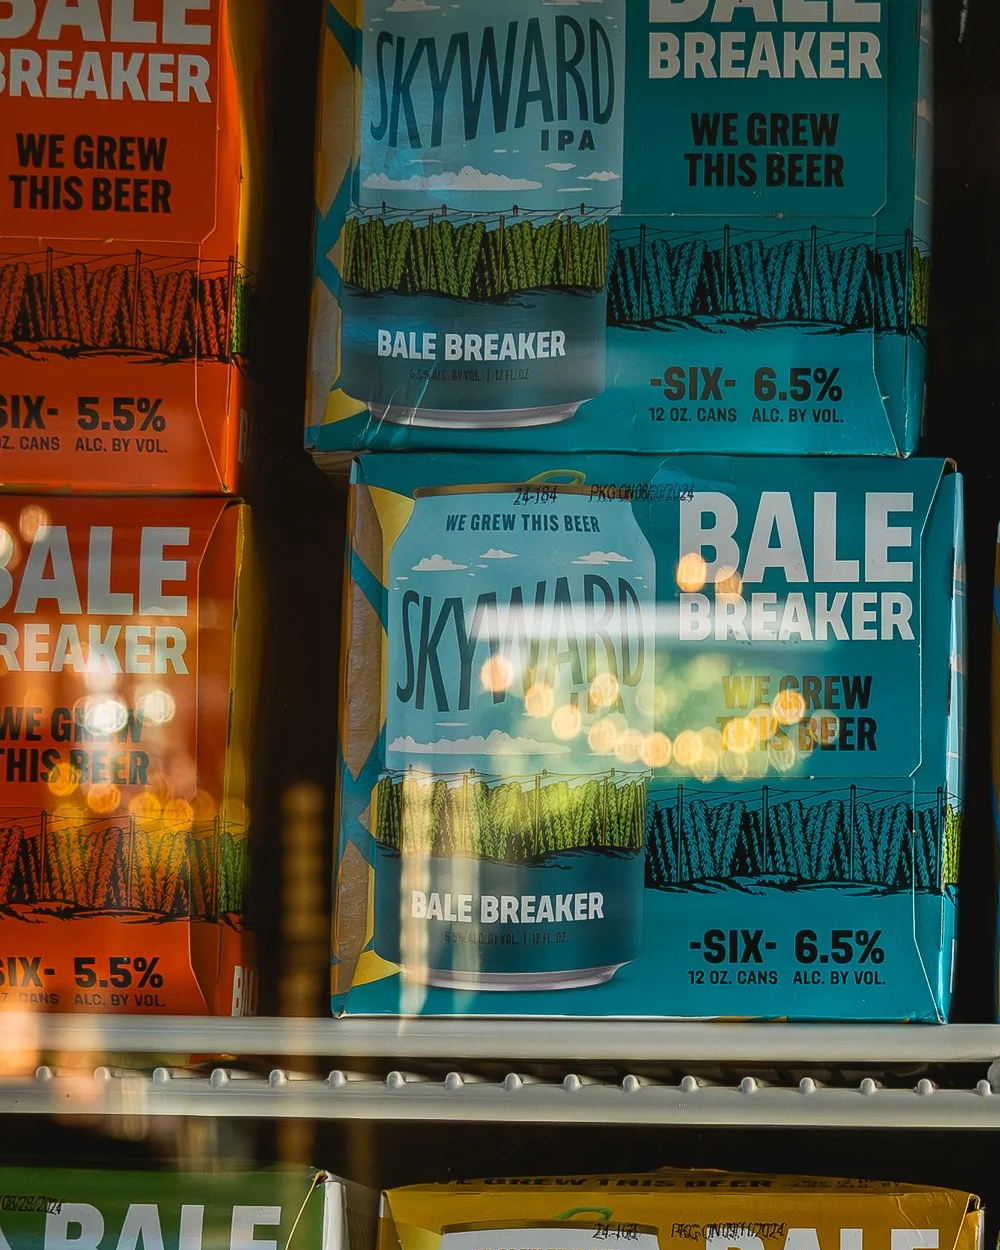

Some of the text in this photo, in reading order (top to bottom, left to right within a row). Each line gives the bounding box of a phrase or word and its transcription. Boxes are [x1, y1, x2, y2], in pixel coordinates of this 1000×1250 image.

[648, 31, 882, 79] BREAKER
[370, 15, 616, 148] SKYWARD
[17, 134, 167, 172] WE GREW
[541, 130, 595, 151] IPA
[9, 175, 171, 213] THIS BEER
[754, 368, 843, 402] 6.5%
[76, 397, 166, 433] 5.5%
[445, 514, 600, 533] WE GREW THIS BEER
[678, 491, 914, 583] BALE
[678, 592, 914, 641] BREAKER
[396, 573, 645, 713] SKYWARD
[411, 891, 604, 923] BALE BREAKER
[793, 929, 885, 964] 6.5%
[75, 956, 163, 989] 5.5%
